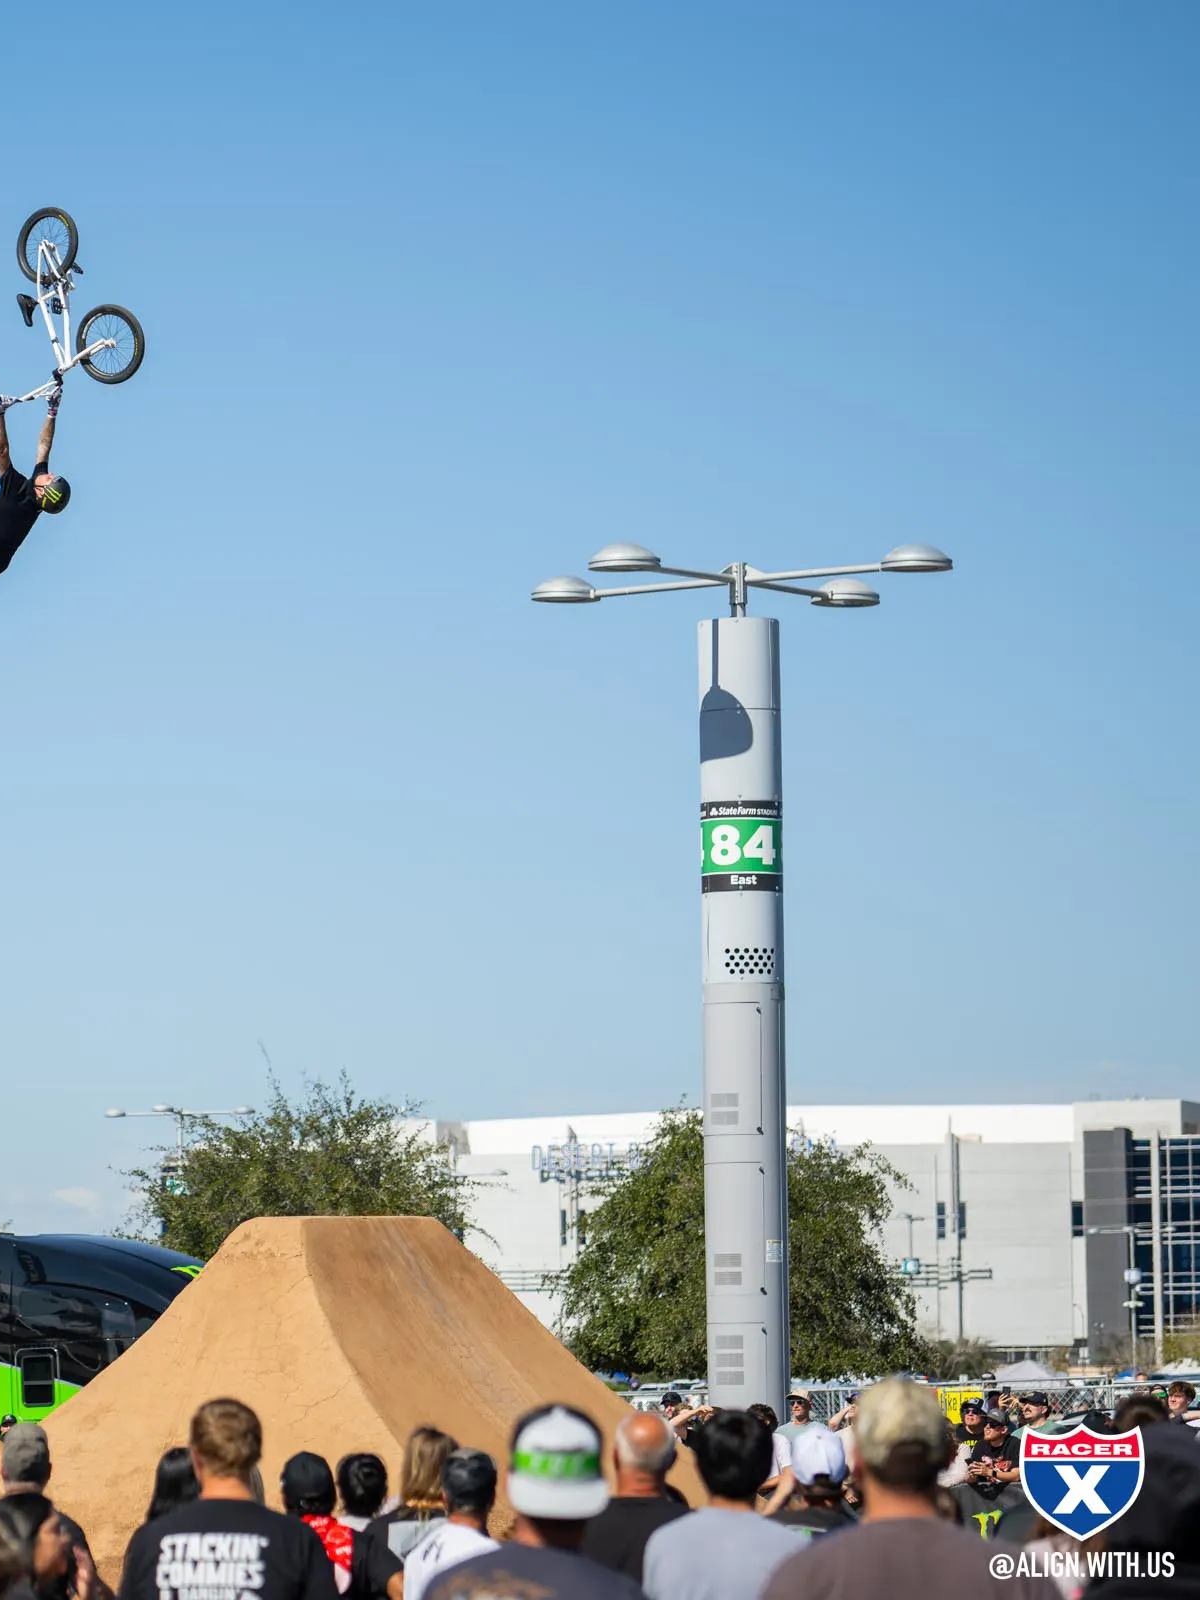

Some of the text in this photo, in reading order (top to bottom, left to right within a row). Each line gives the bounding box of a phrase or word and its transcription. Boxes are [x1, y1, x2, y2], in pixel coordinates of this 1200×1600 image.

[710, 824, 776, 866] 84
[730, 874, 757, 885] East
[156, 1560, 265, 1588] COMMIES
